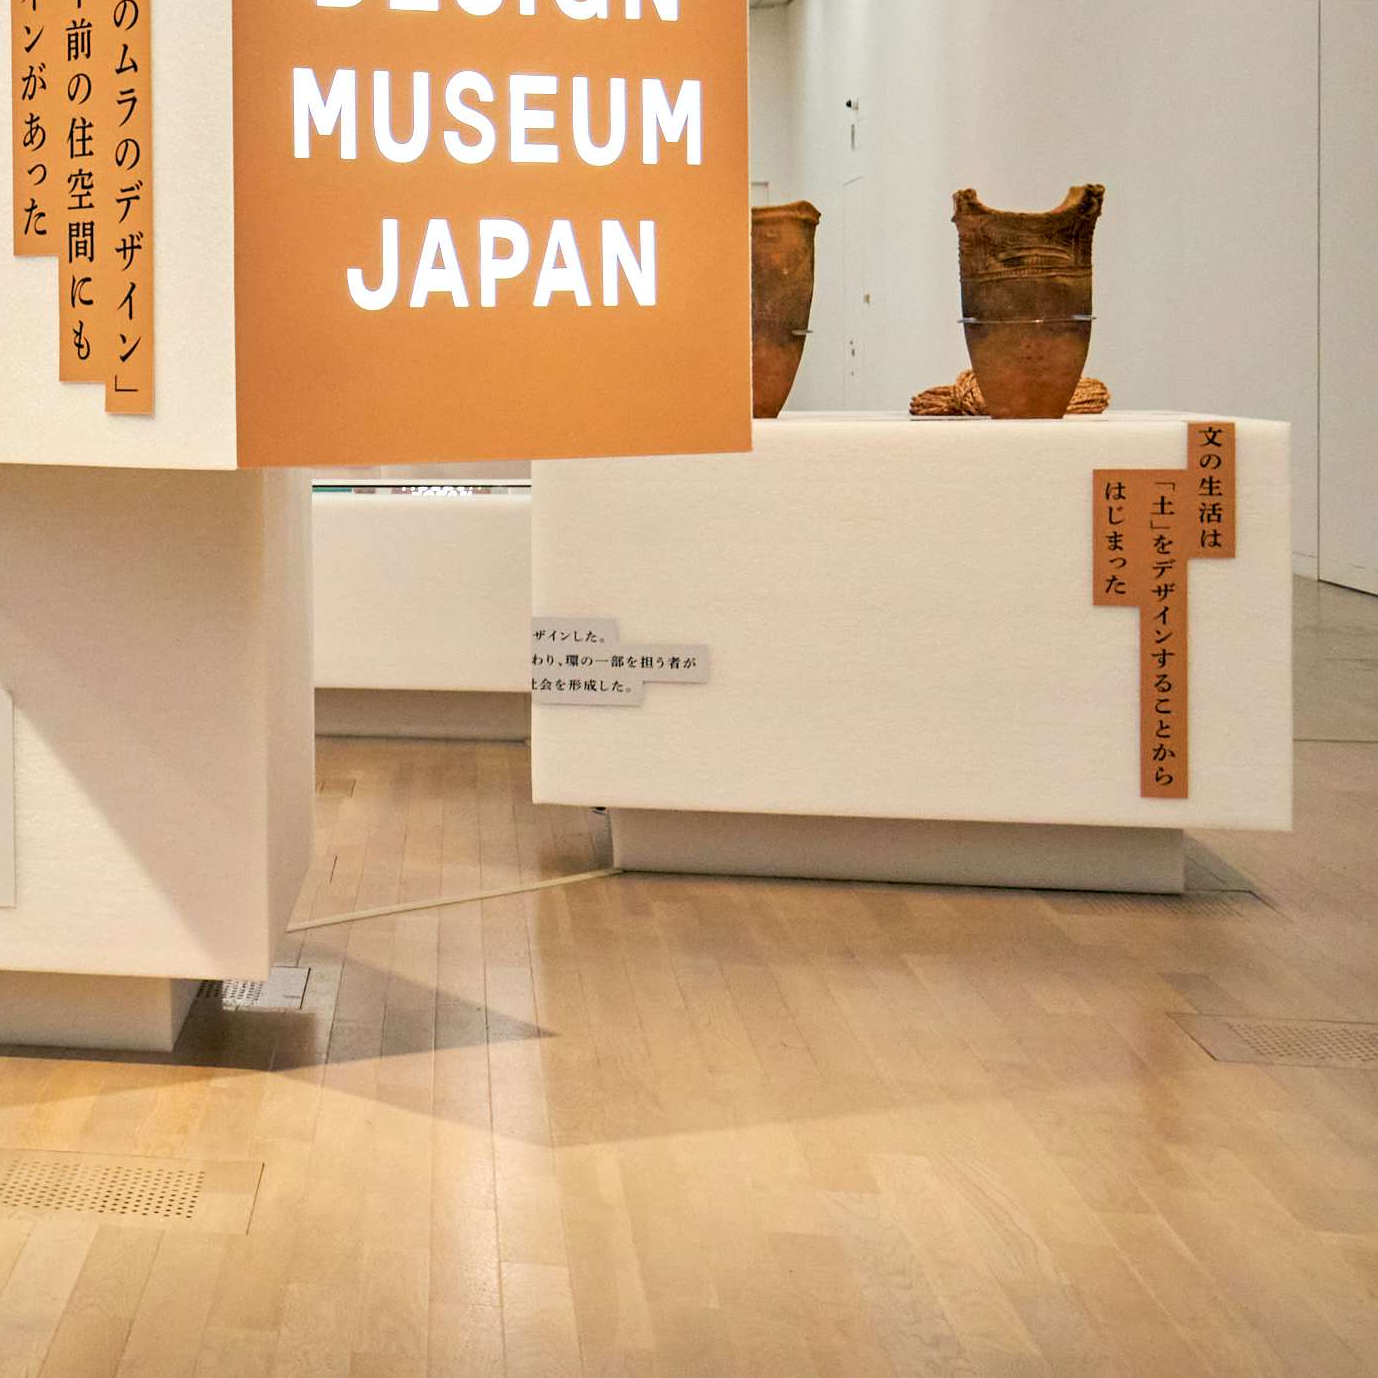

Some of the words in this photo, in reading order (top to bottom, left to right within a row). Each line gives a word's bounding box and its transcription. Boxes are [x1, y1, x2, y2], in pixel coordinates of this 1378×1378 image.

[292, 67, 703, 167] MUSEUM
[346, 217, 657, 311] JAPAN
[1104, 481, 1127, 595] はじまった
[1198, 426, 1223, 549] 文の生活は
[1150, 481, 1176, 786] 「土」をデザインすることから
